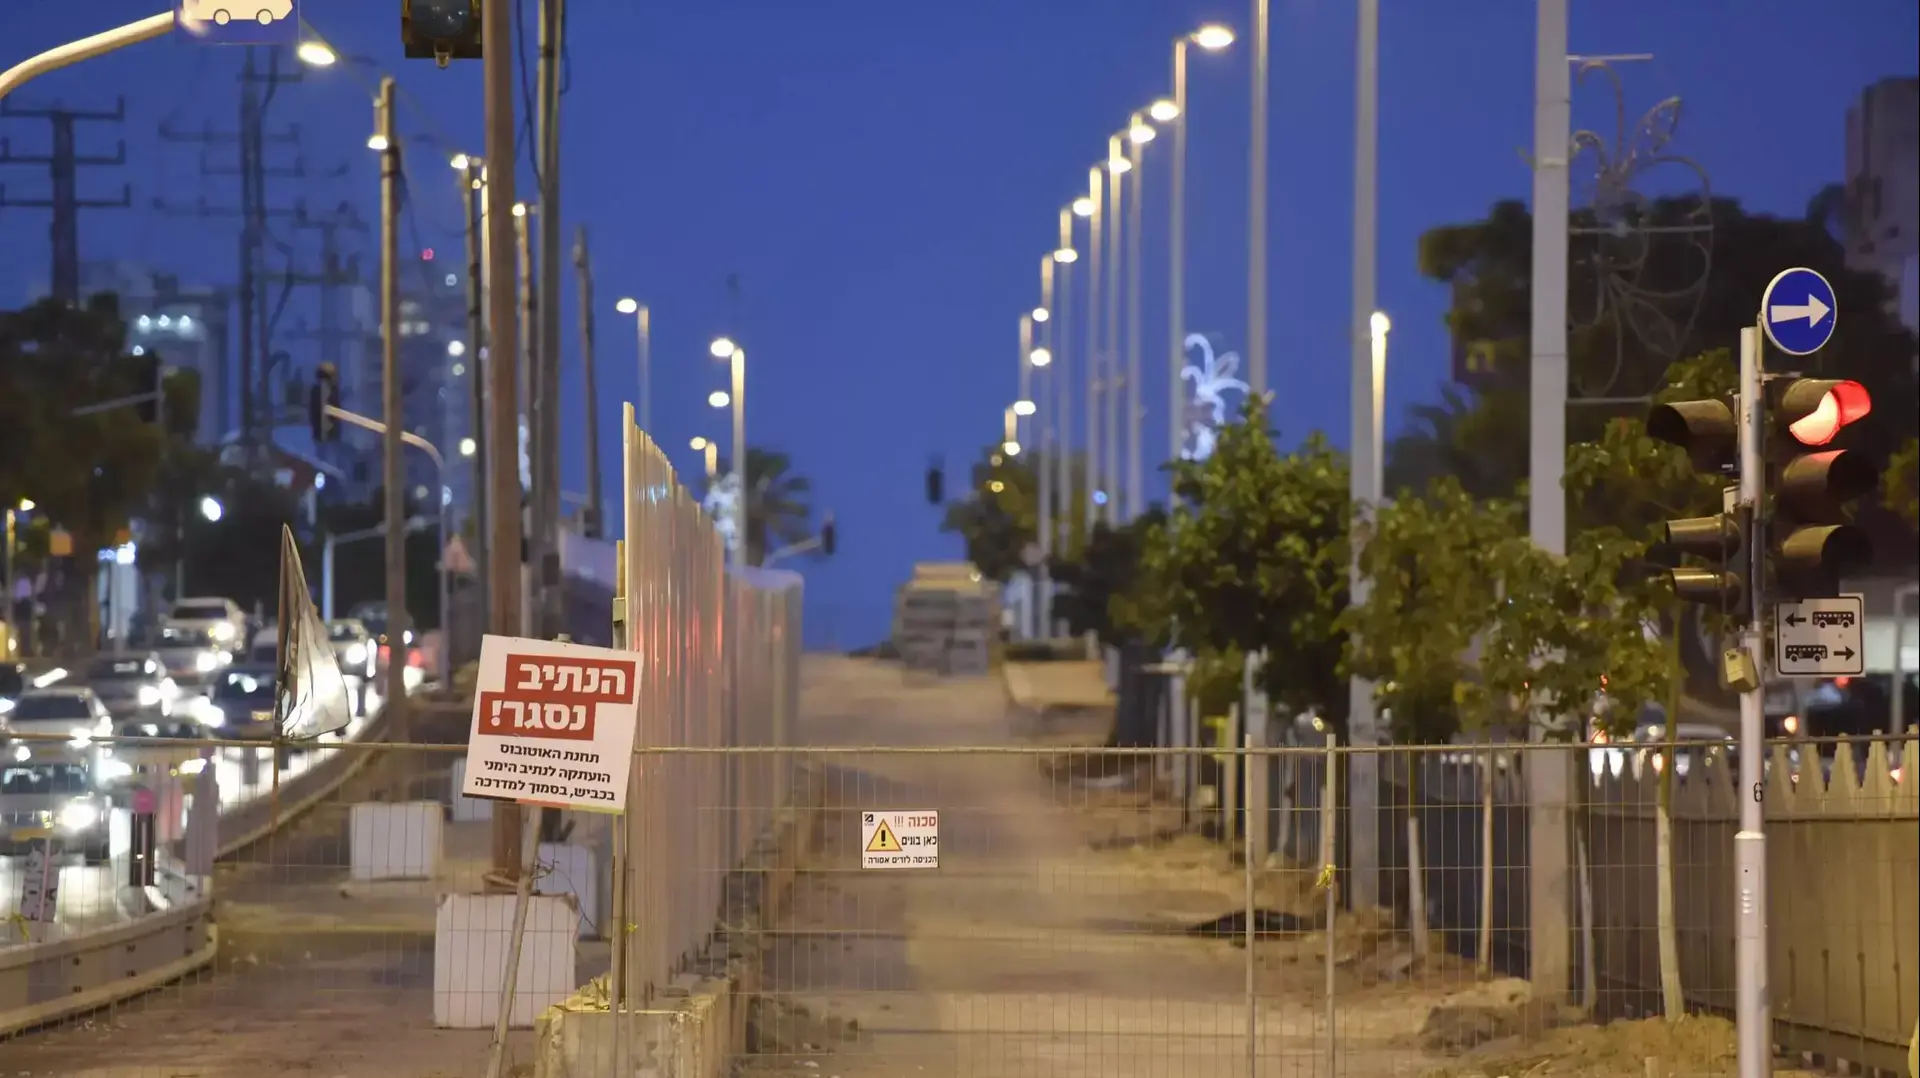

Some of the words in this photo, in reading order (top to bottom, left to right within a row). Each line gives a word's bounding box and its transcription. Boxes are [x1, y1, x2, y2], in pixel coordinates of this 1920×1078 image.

[517, 663, 626, 695] הנתיב
[490, 700, 587, 731] נסגר!
[500, 744, 561, 760] האוטובוס
[564, 751, 600, 764] תחנת
[484, 760, 517, 773] הימני
[519, 764, 556, 777] לנתיב
[558, 767, 611, 783] הועתקה
[474, 776, 525, 791] למדרכה
[529, 781, 569, 796] בסמוך
[569, 787, 616, 801] בכביש,
[1753, 782, 1763, 802] 6
[908, 816, 936, 828] סכנה
[901, 836, 921, 846] בונים
[923, 836, 937, 847] כאן
[892, 855, 911, 864] לזרים
[913, 856, 937, 864] הכניסה
